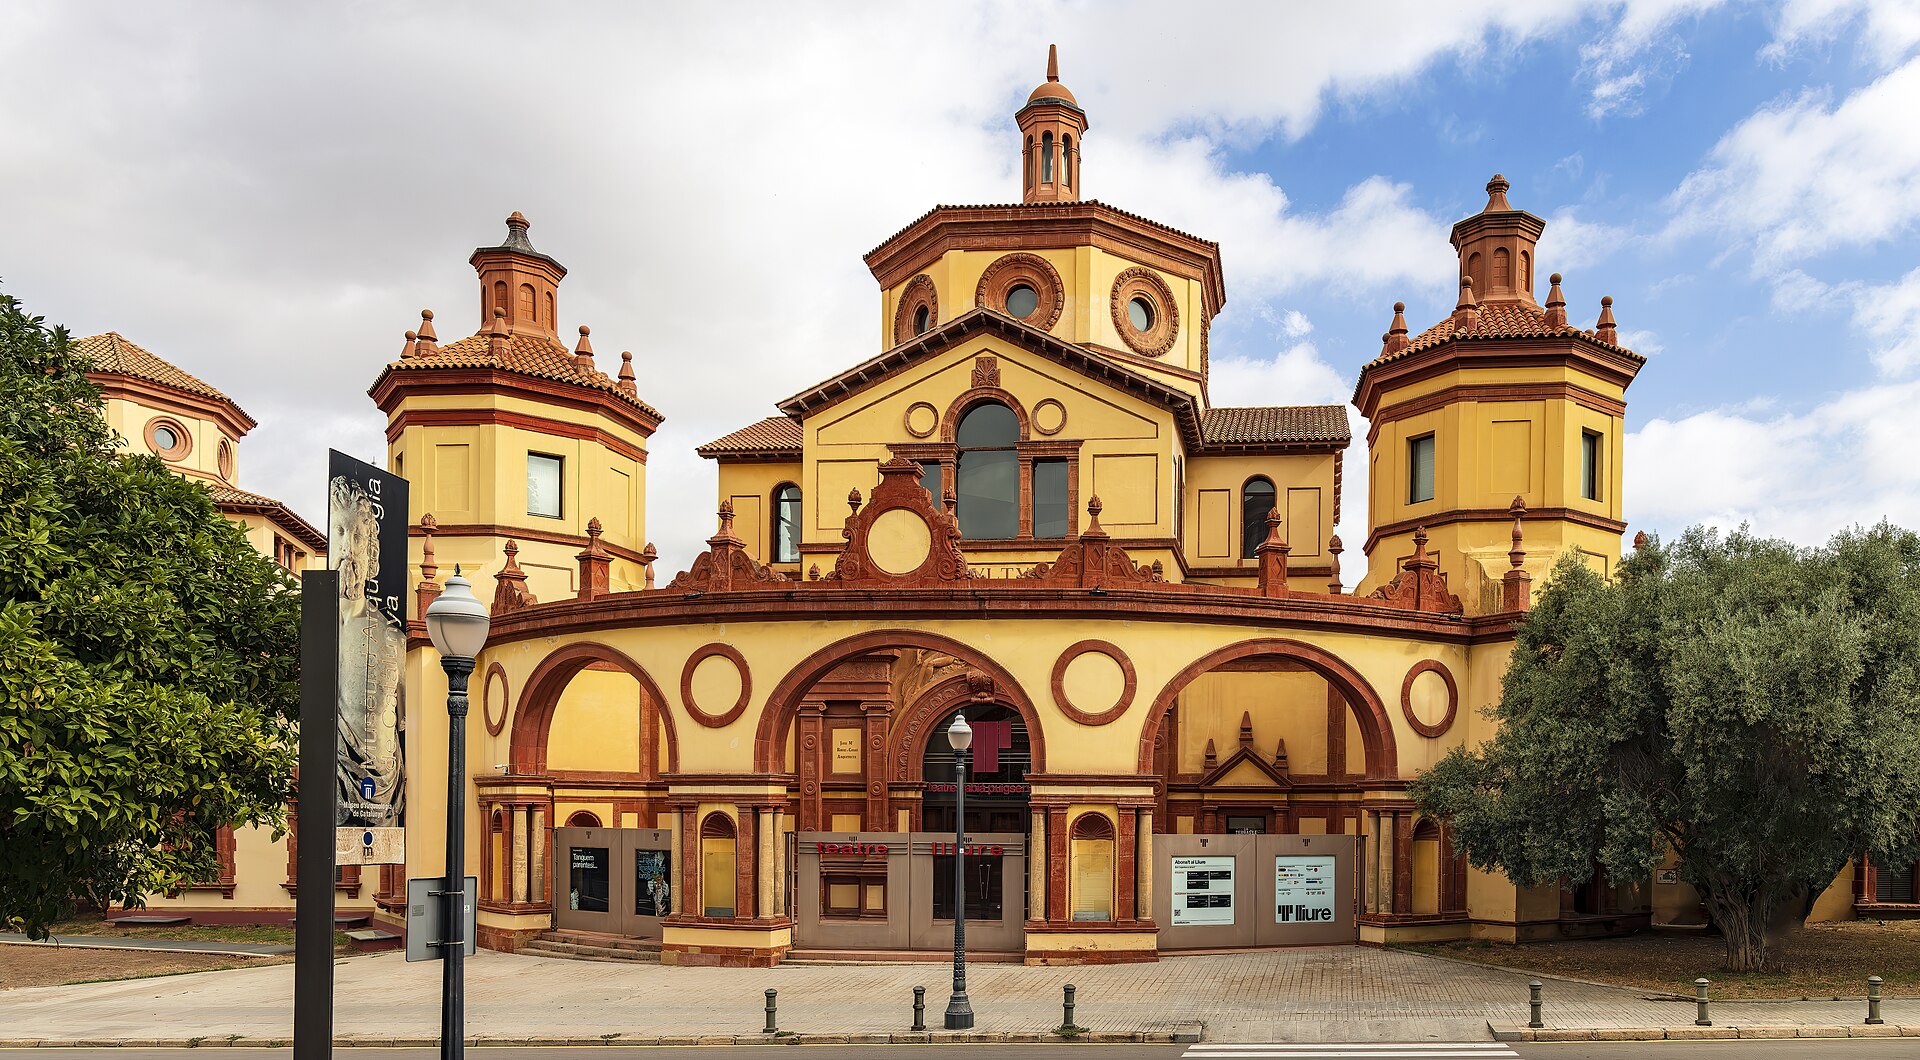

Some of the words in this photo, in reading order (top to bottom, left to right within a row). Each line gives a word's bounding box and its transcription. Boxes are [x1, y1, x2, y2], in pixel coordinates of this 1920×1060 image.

[382, 596, 402, 728] Catalunya
[360, 680, 377, 770] Museu
[382, 739, 396, 770] de
[926, 783, 957, 793] teatre
[816, 841, 889, 855] teatre
[931, 842, 1004, 856] lliure
[573, 853, 594, 861] Tanquem
[1296, 905, 1331, 921] lliure
